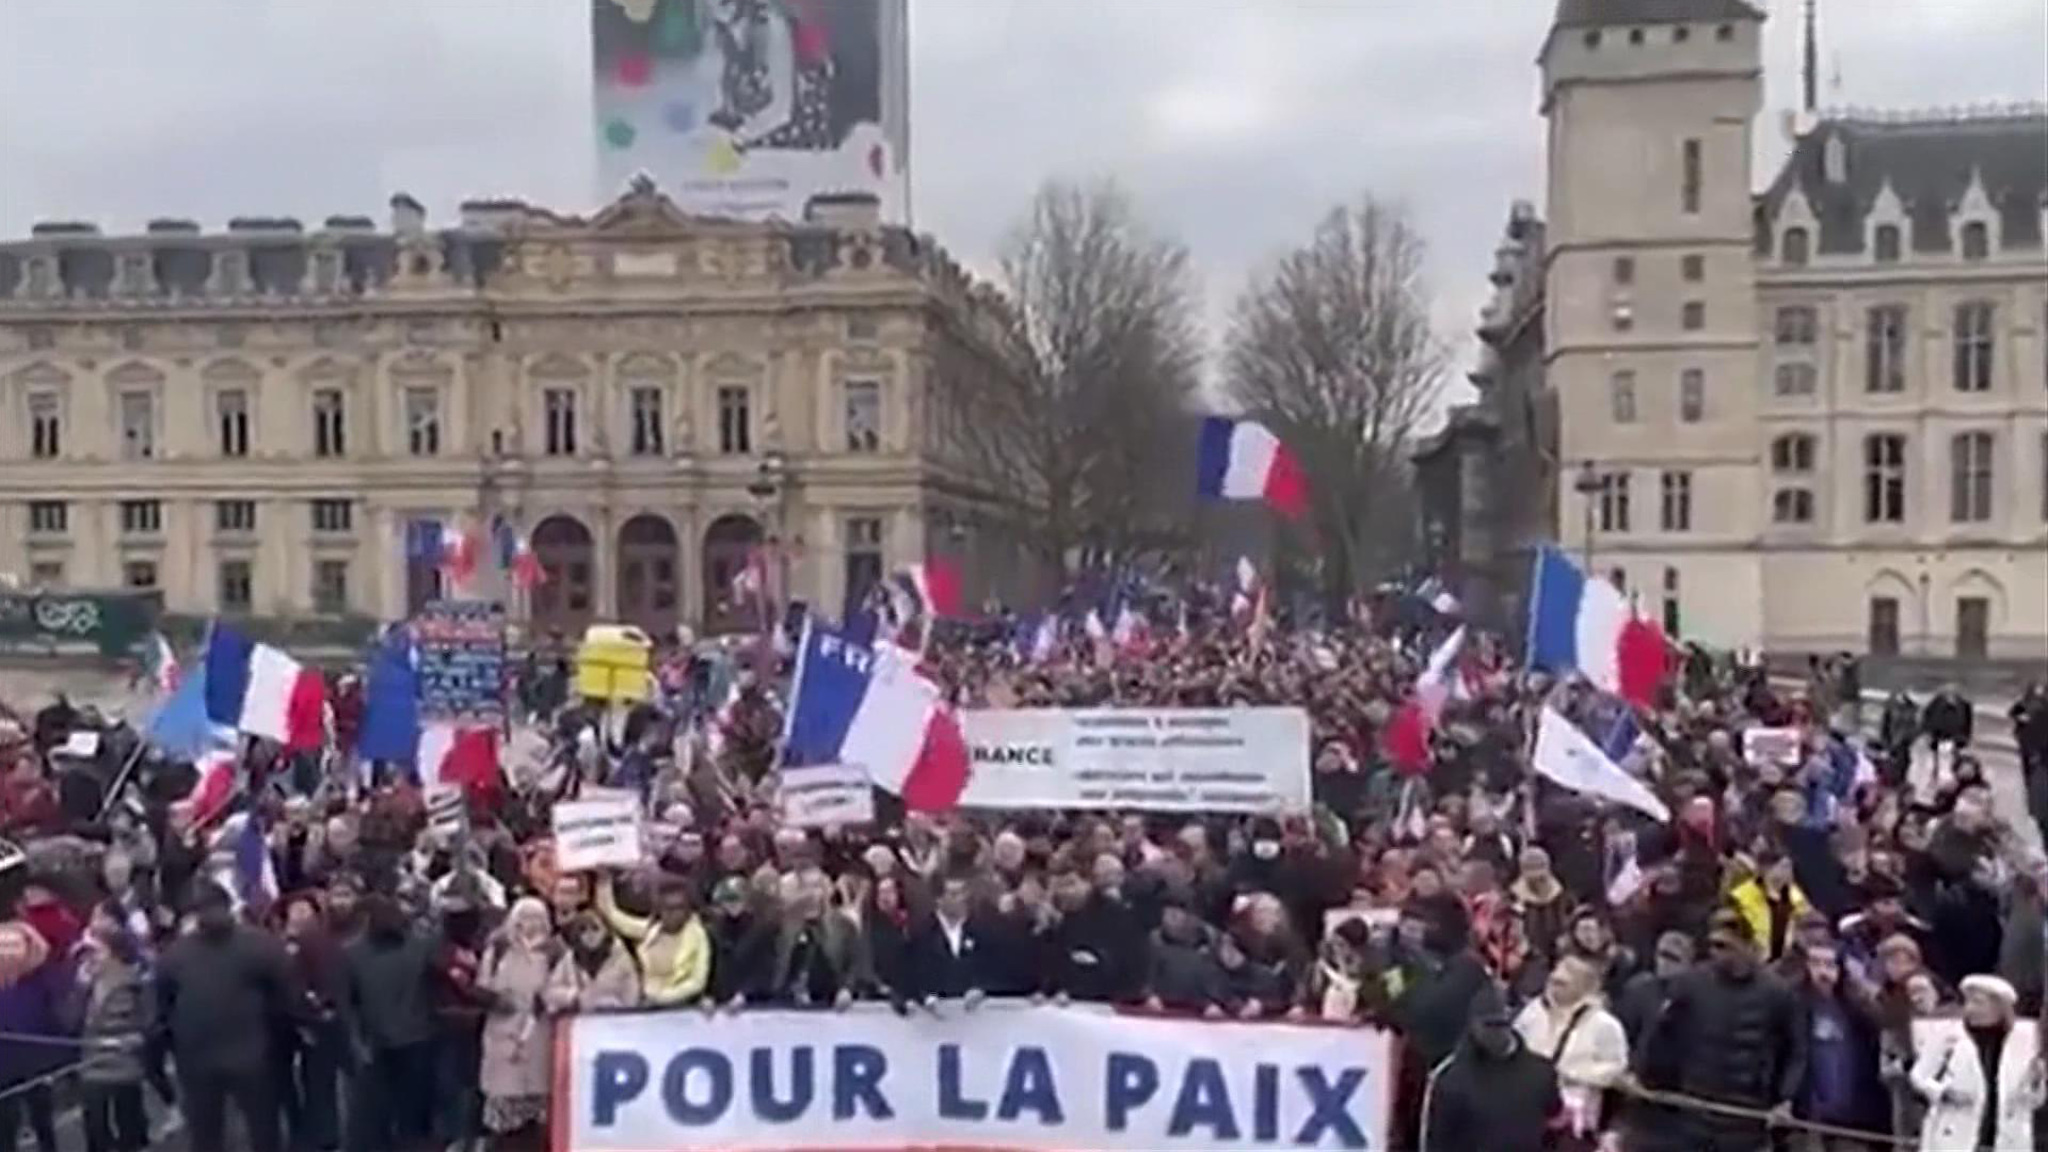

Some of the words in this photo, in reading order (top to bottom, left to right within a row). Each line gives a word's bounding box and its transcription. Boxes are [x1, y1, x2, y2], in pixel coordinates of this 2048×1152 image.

[973, 746, 1054, 766] RANCE
[591, 1043, 896, 1127] POUR
[937, 1043, 1066, 1126] LA
[1105, 1051, 1369, 1149] PAIX
